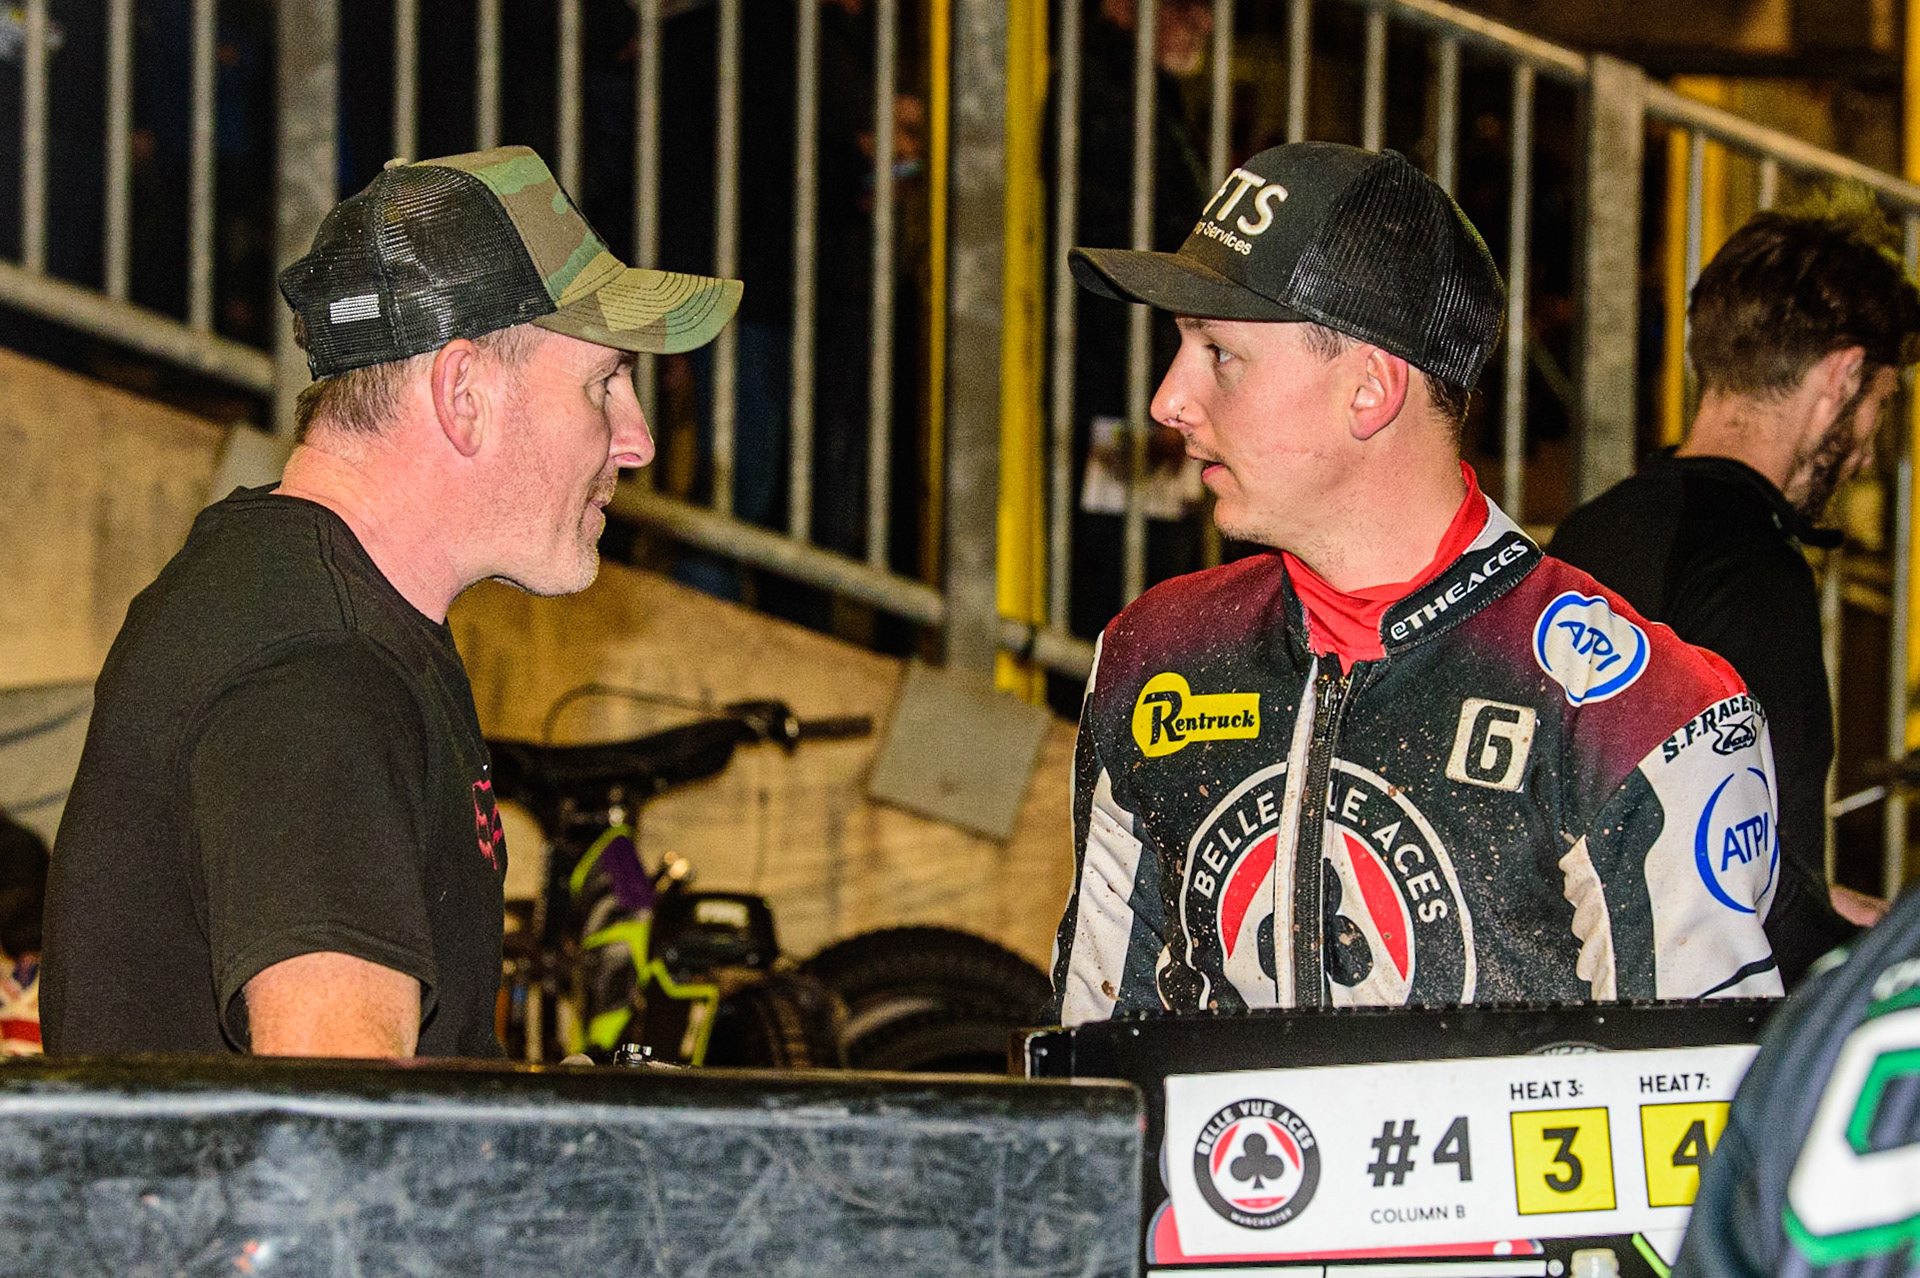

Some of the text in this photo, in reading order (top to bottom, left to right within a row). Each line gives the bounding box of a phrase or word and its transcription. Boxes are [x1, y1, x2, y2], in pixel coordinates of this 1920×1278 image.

[1204, 221, 1252, 256] Services
[1390, 540, 1529, 641] @THEACES
[1142, 690, 1255, 746] Rentruck
[1193, 791, 1284, 899] BELLE
[1371, 821, 1448, 925] ACES
[1720, 812, 1768, 872] ATPI
[1510, 1079, 1584, 1101] HEAT 3:
[1639, 1072, 1711, 1094] HEAT 7:
[1196, 1100, 1316, 1156] BELLE VUE ACES
[1671, 1119, 1712, 1168] 4
[1542, 1126, 1584, 1193] 3
[1370, 1204, 1466, 1225] COLUMN B
